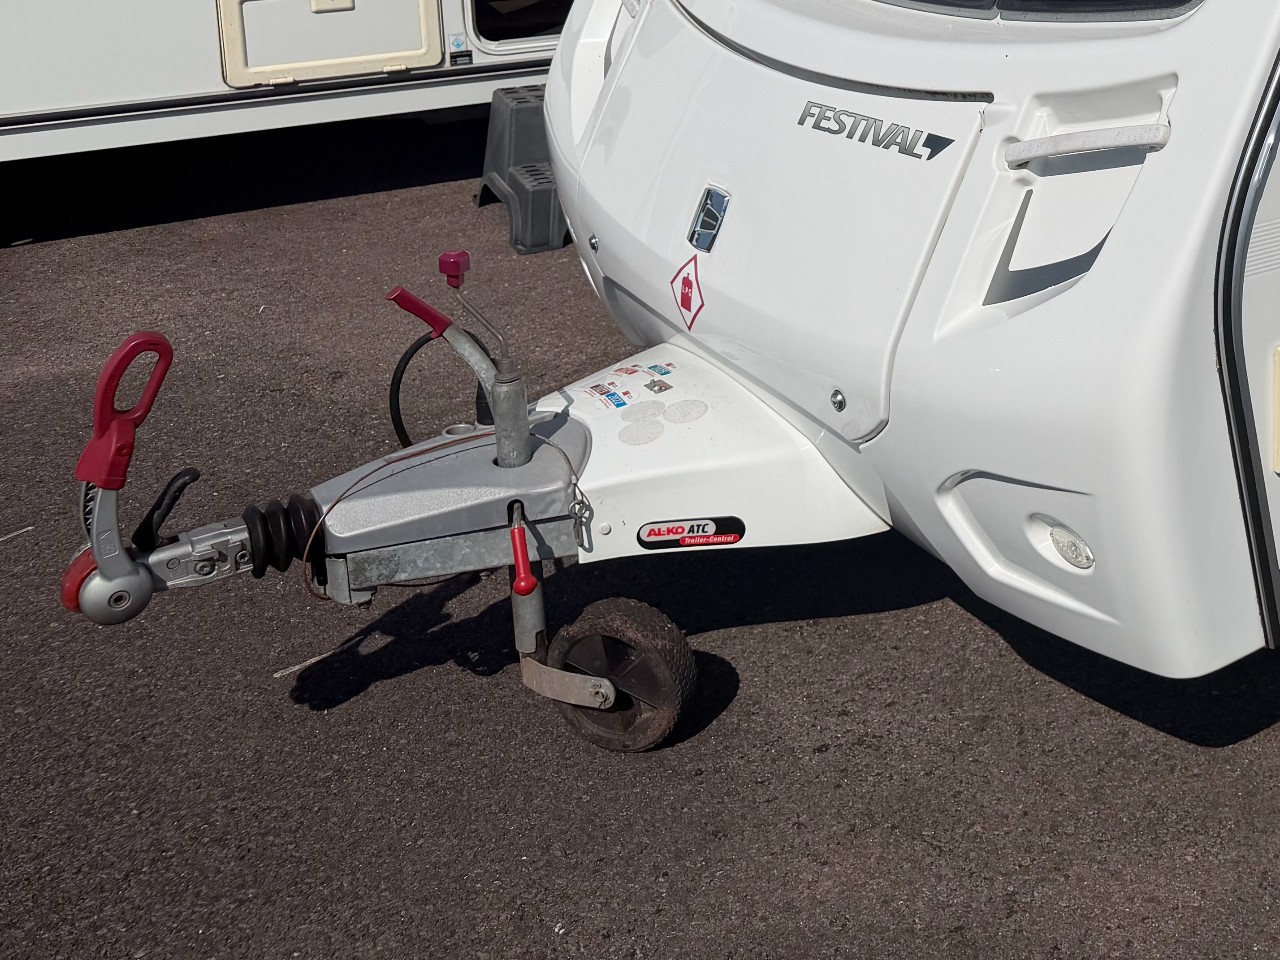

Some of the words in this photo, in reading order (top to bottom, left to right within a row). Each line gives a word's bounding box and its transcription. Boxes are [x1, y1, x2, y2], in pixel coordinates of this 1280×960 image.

[797, 100, 923, 159] FESTIVAL
[682, 286, 692, 297] LPG
[686, 523, 710, 535] ATC
[684, 535, 734, 544] Trailer-Control
